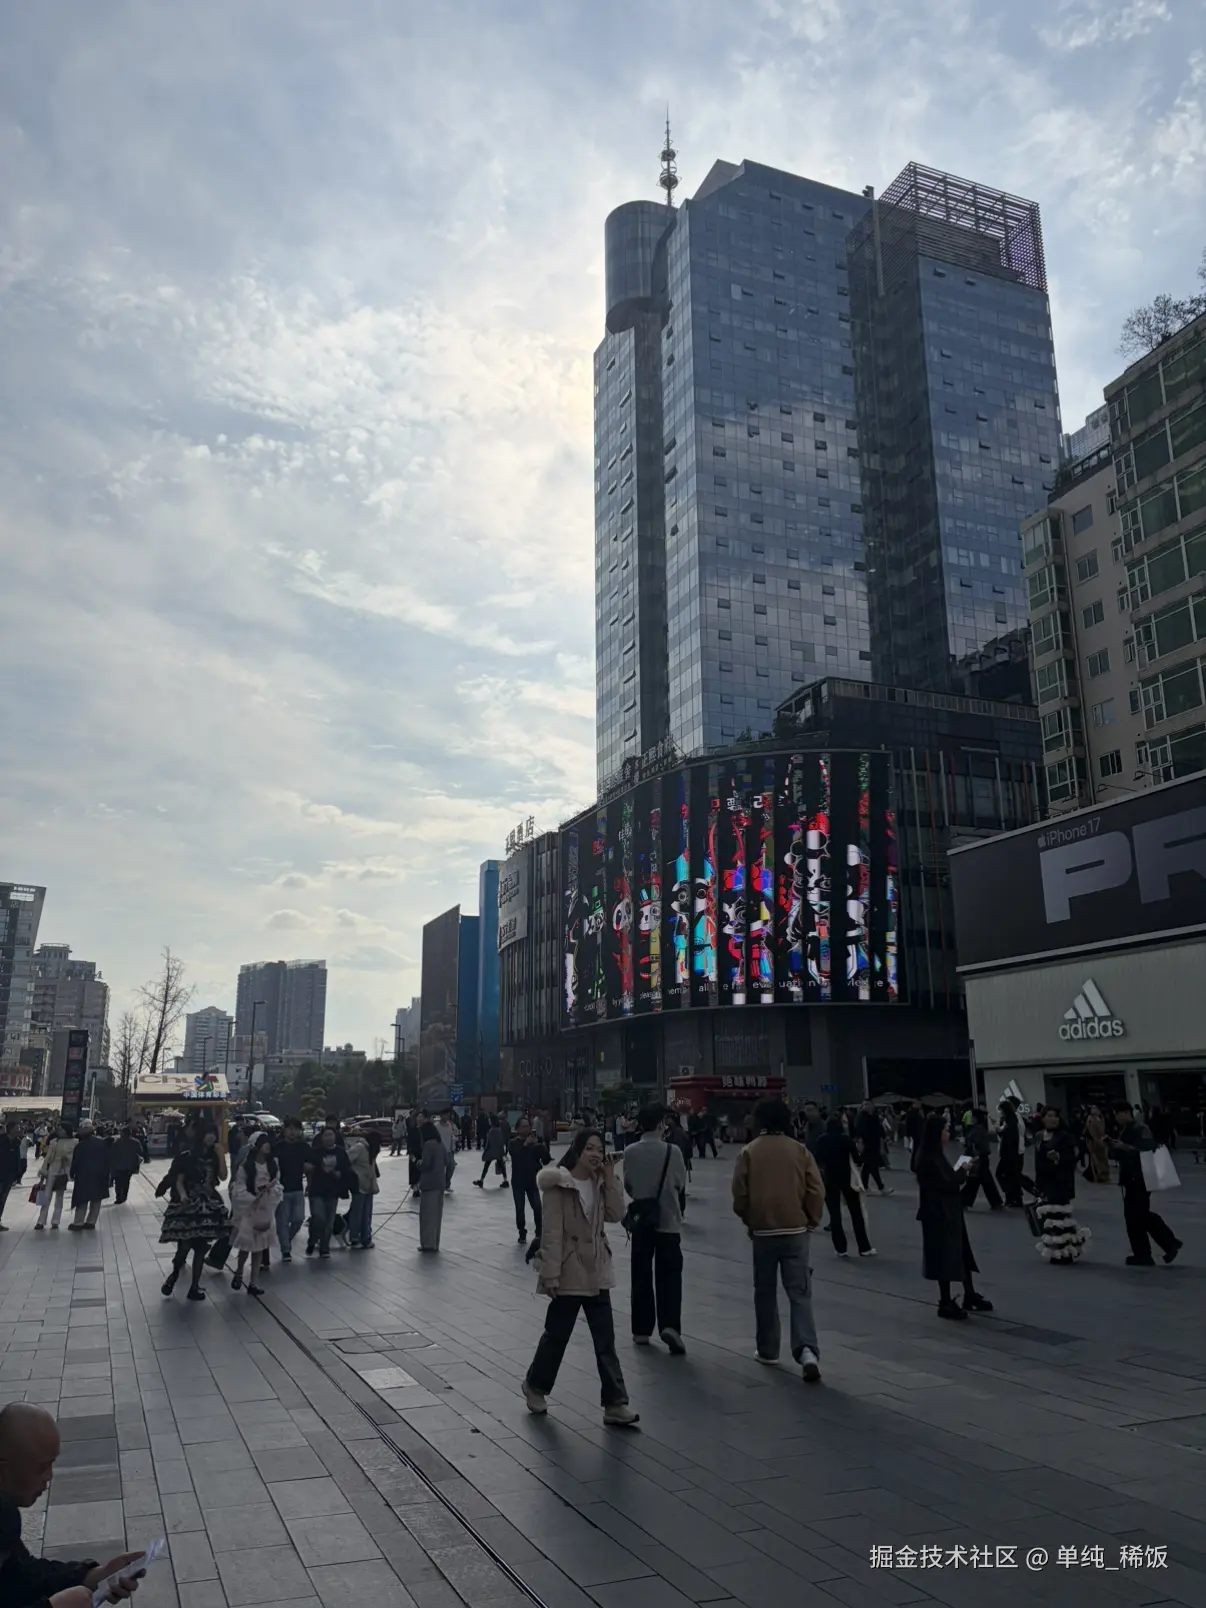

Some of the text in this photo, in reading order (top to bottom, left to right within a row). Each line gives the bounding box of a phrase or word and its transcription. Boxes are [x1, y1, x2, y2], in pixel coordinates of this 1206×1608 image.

[1046, 817, 1101, 847] iPhone 17
[1058, 1016, 1124, 1040] adidas
